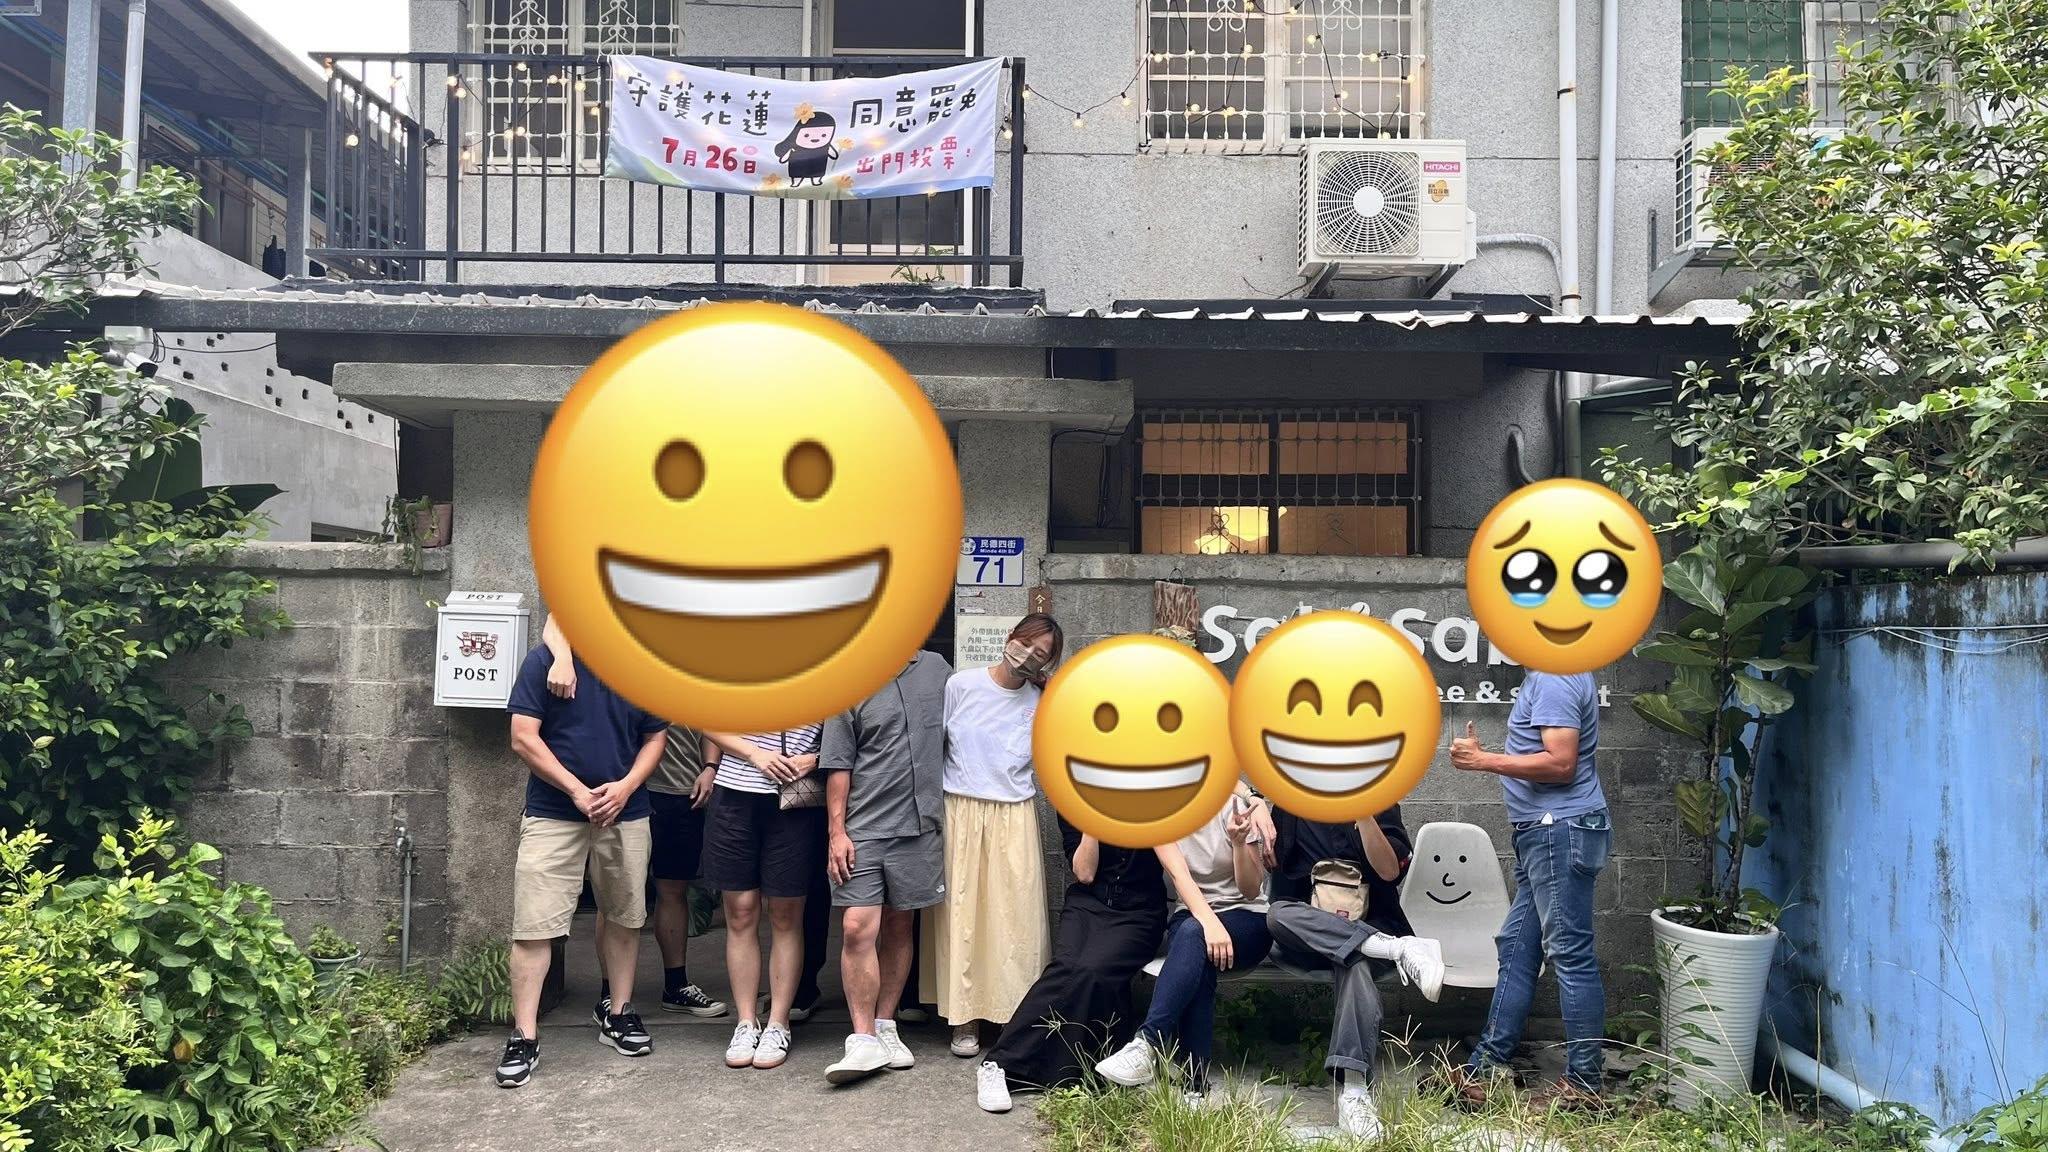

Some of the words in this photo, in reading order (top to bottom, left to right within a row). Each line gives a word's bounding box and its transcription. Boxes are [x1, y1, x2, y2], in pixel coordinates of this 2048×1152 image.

[627, 73, 771, 136] 守護花蓮
[850, 84, 977, 133] 同意罷免
[1424, 162, 1459, 170] HITACHI
[980, 539, 1017, 549] 民德四街
[973, 557, 1004, 583] 71
[453, 667, 498, 681] POST
